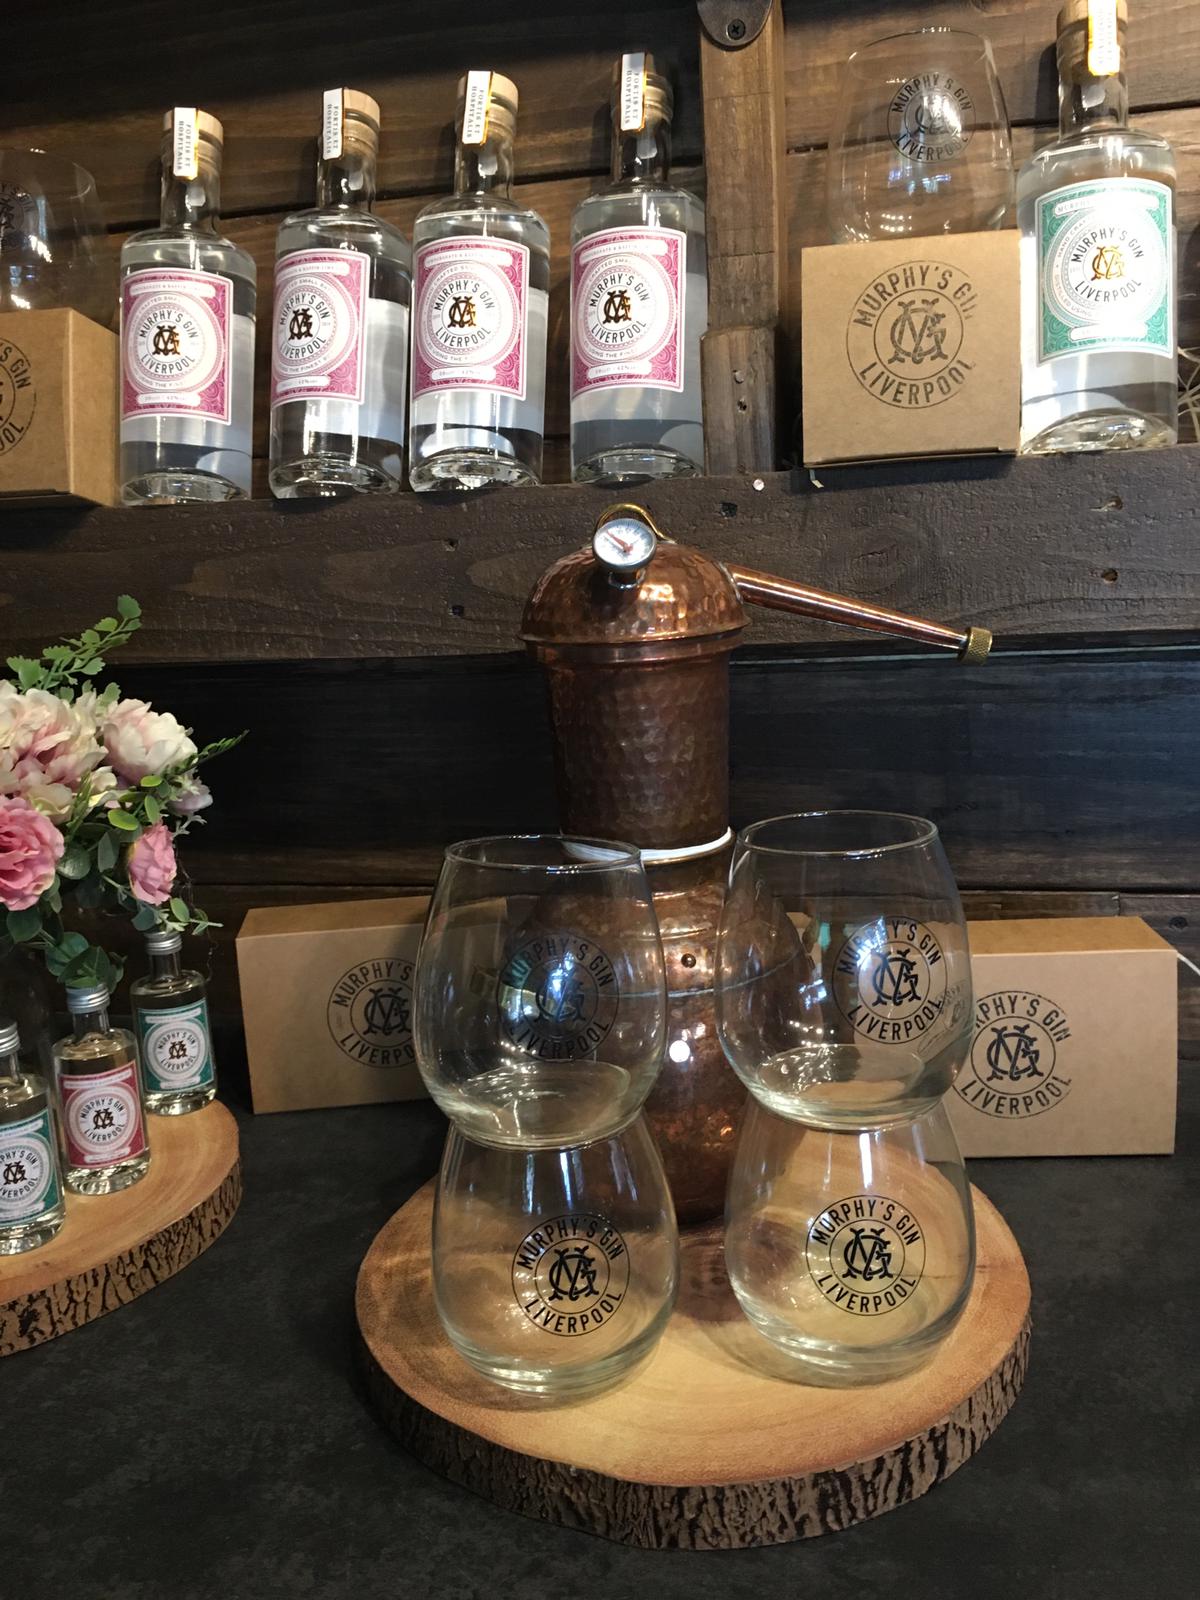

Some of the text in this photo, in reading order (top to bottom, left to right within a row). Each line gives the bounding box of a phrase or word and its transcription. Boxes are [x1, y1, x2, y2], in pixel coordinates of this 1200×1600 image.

[953, 87, 972, 110] GIN
[1071, 226, 1144, 263] MURPHY'S GIN
[434, 280, 496, 310] MURPHY'S GIN
[589, 273, 651, 307] MURPHY'S GIN
[853, 265, 953, 328] MURPHY'S
[1074, 280, 1142, 303] LIVERPOOL
[139, 310, 199, 339] MURPHY'S GIN
[279, 292, 331, 326] MURPHY'S GIN
[279, 336, 327, 359] LIVERPOOL
[435, 327, 492, 348] LIVERPOOL
[591, 320, 647, 343] LIVERPOOL
[10, 358, 31, 390] GIN
[141, 353, 195, 374] LIVERPOOL
[859, 360, 976, 405] LIVERPOOL
[837, 919, 942, 977] MURPY'S GIN
[332, 961, 412, 1008] MURPHY'S
[588, 955, 614, 988] GIN
[847, 999, 943, 1041] LIVERPOOL
[976, 994, 1041, 1030] PHY'S
[1042, 1009, 1072, 1043] GIN
[158, 1031, 186, 1050] MURPHY'S
[339, 1033, 416, 1065] LIVERPO
[510, 1022, 611, 1060] LIVERPOOL
[80, 1097, 125, 1119] MURPHY'S GIN
[961, 1076, 1072, 1116] LIVERPOOL
[85, 1123, 125, 1142] LIVERPOOL
[0, 1149, 38, 1166] PHY'S GIN
[0, 1176, 38, 1198] VERPOOL
[812, 1199, 920, 1246] MURPHY'S GIN
[517, 1218, 624, 1270] MURPHY'S GIN
[818, 1274, 916, 1313] LIVERPOOL
[524, 1293, 622, 1333] LIVERPOOL
